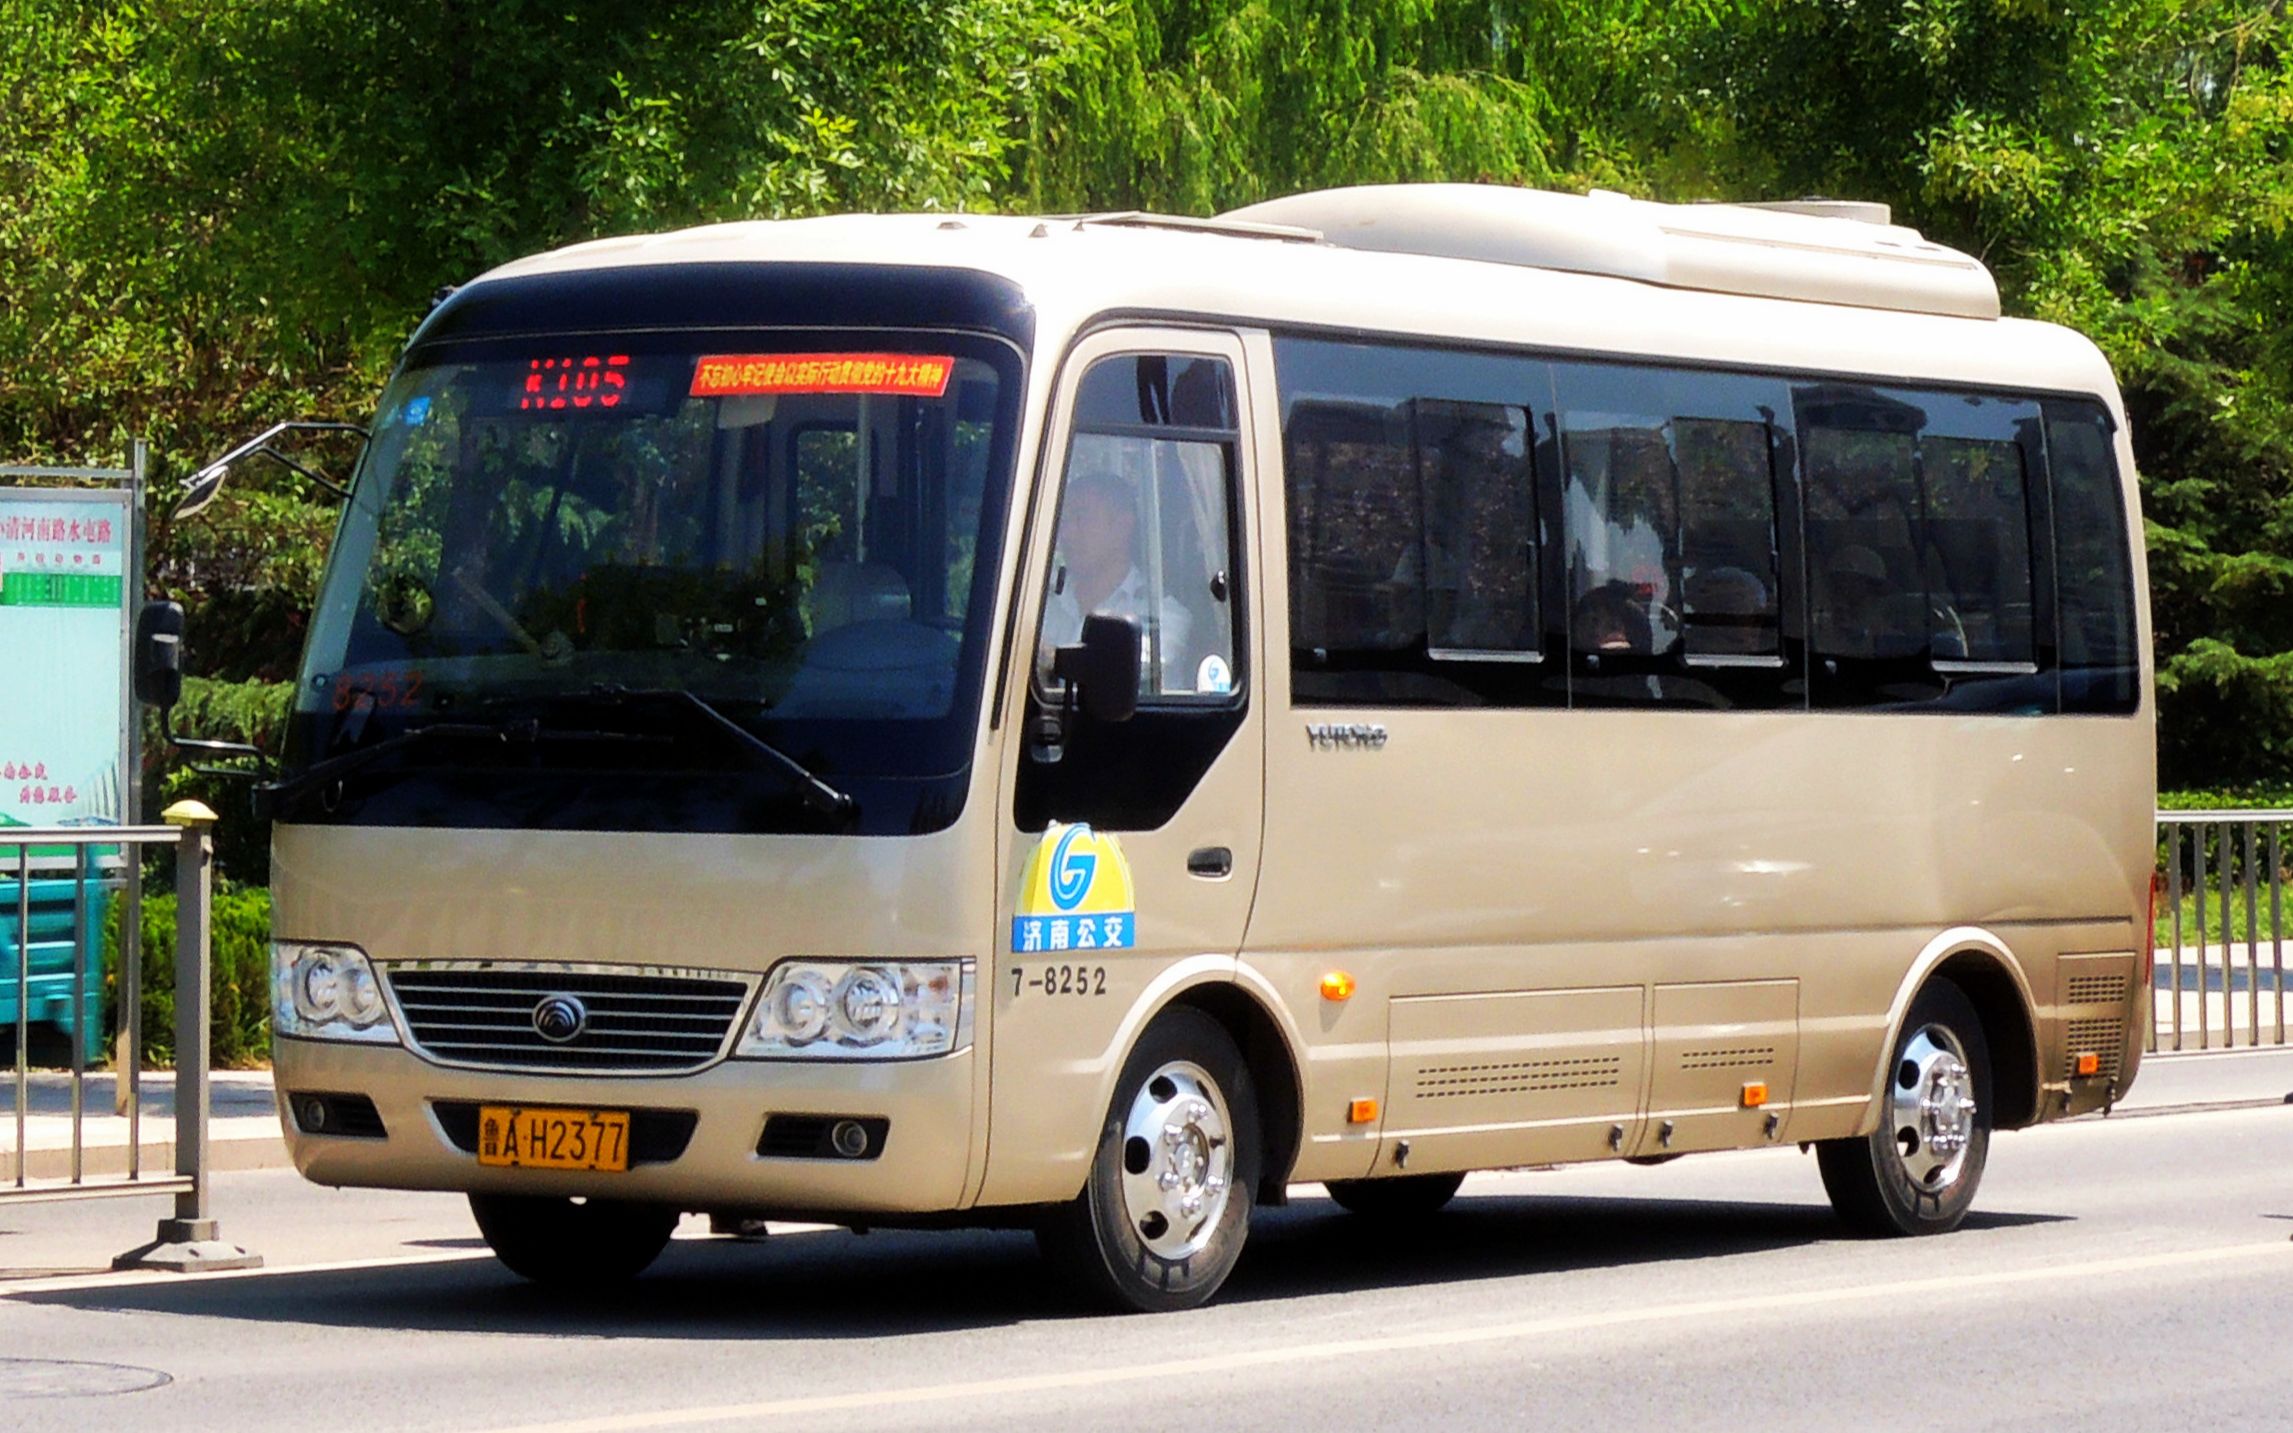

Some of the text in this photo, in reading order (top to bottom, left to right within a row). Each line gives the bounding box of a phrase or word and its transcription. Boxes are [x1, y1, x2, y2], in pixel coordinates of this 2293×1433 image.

[521, 355, 631, 410] K105
[0, 516, 111, 543] 清河南路水屯路
[1023, 917, 1124, 952] 济南公交
[1011, 965, 1107, 997] 7-8252
